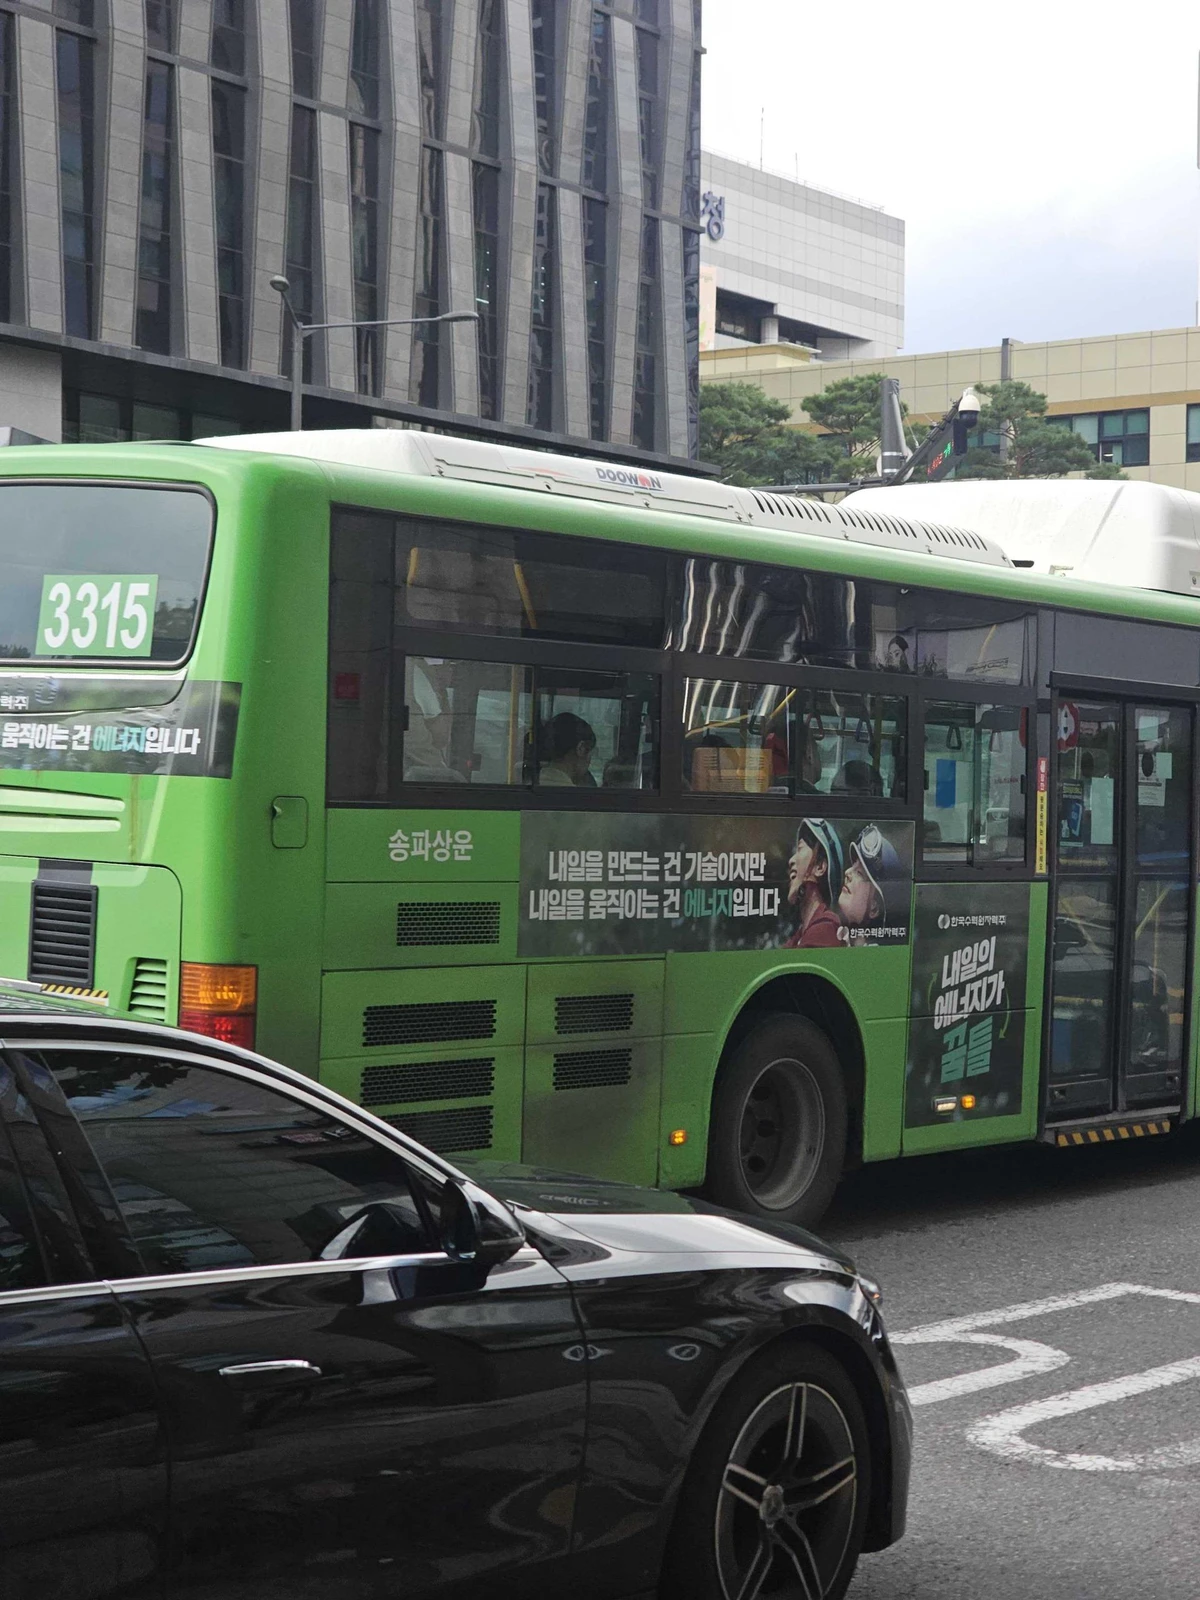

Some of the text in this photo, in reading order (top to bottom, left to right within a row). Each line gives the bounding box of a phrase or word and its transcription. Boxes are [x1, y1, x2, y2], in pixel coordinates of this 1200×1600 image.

[700, 191, 725, 240] 청
[44, 582, 150, 650] 3315
[1, 722, 201, 755] 움직이는 건 에너지입니다
[388, 829, 474, 862] 송파상운
[548, 851, 766, 882] 내일을 만드는 건 기술이지만
[529, 887, 781, 920] 내일을 움직이는 건 에너지입니다
[941, 935, 997, 989] 내일의
[934, 970, 1006, 1030] 에너지가
[941, 1015, 994, 1084] 꿈틀
